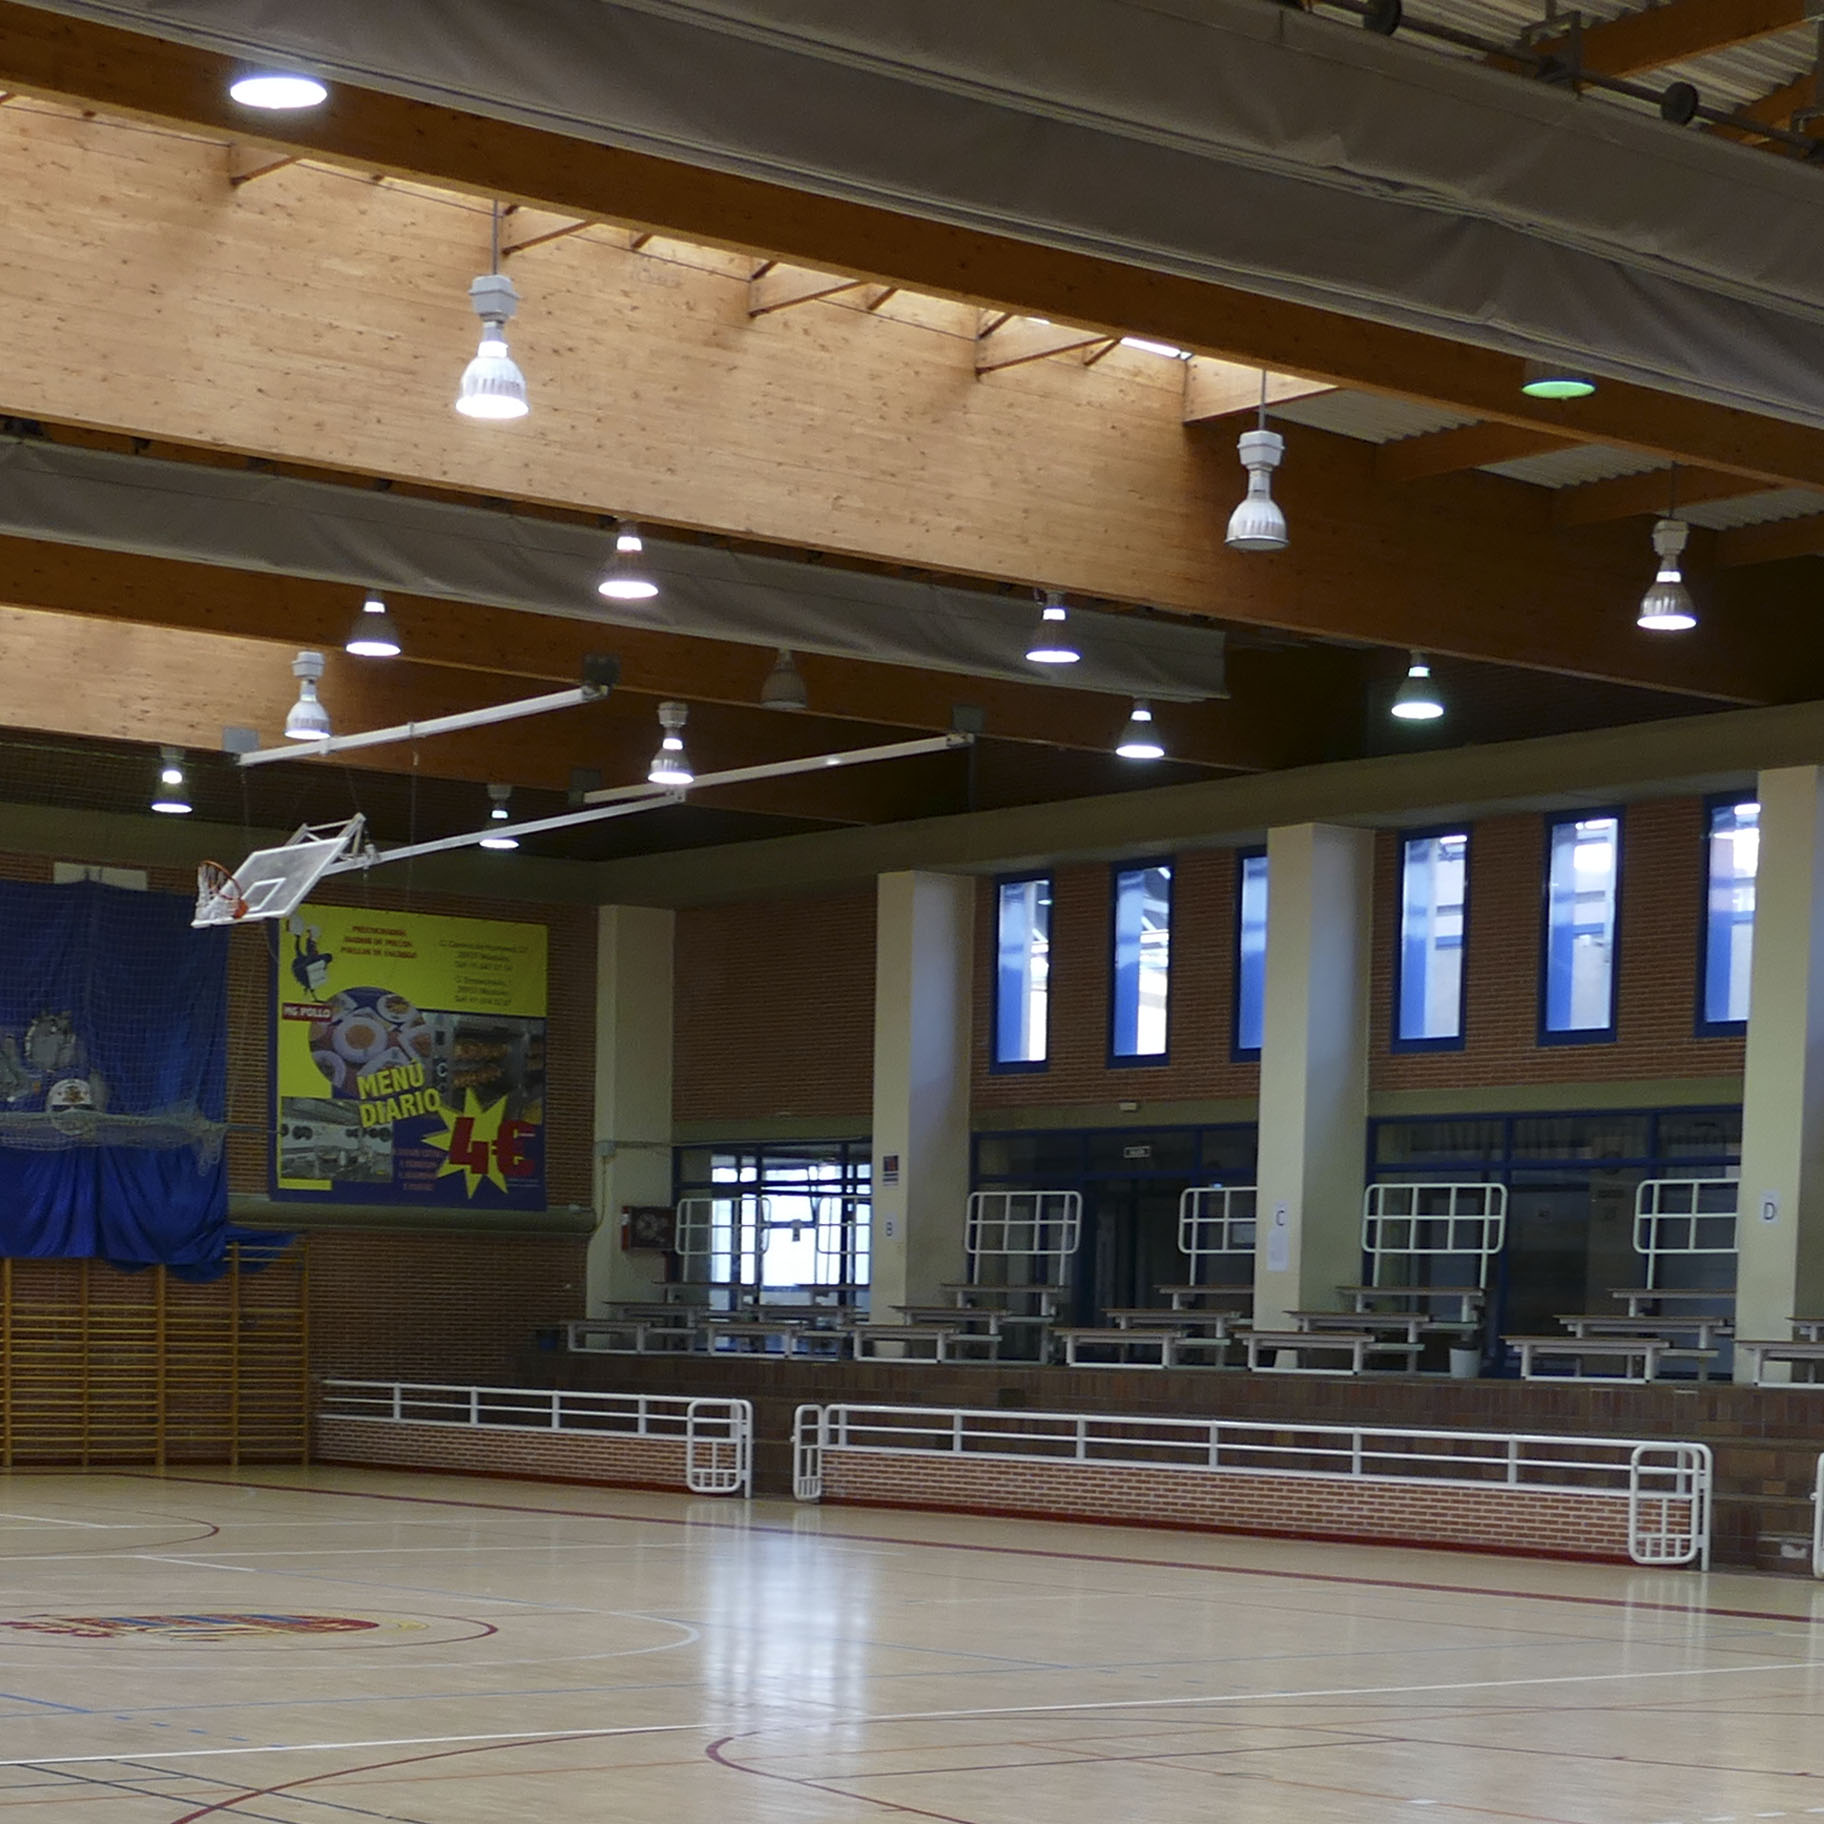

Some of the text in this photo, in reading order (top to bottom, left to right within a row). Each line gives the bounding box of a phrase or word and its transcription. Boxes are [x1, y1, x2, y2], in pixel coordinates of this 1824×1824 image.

[357, 1060, 425, 1099] MENÚ
[359, 1089, 442, 1128] DIARIO
[1275, 1209, 1285, 1227] C
[1763, 1202, 1778, 1220] D
